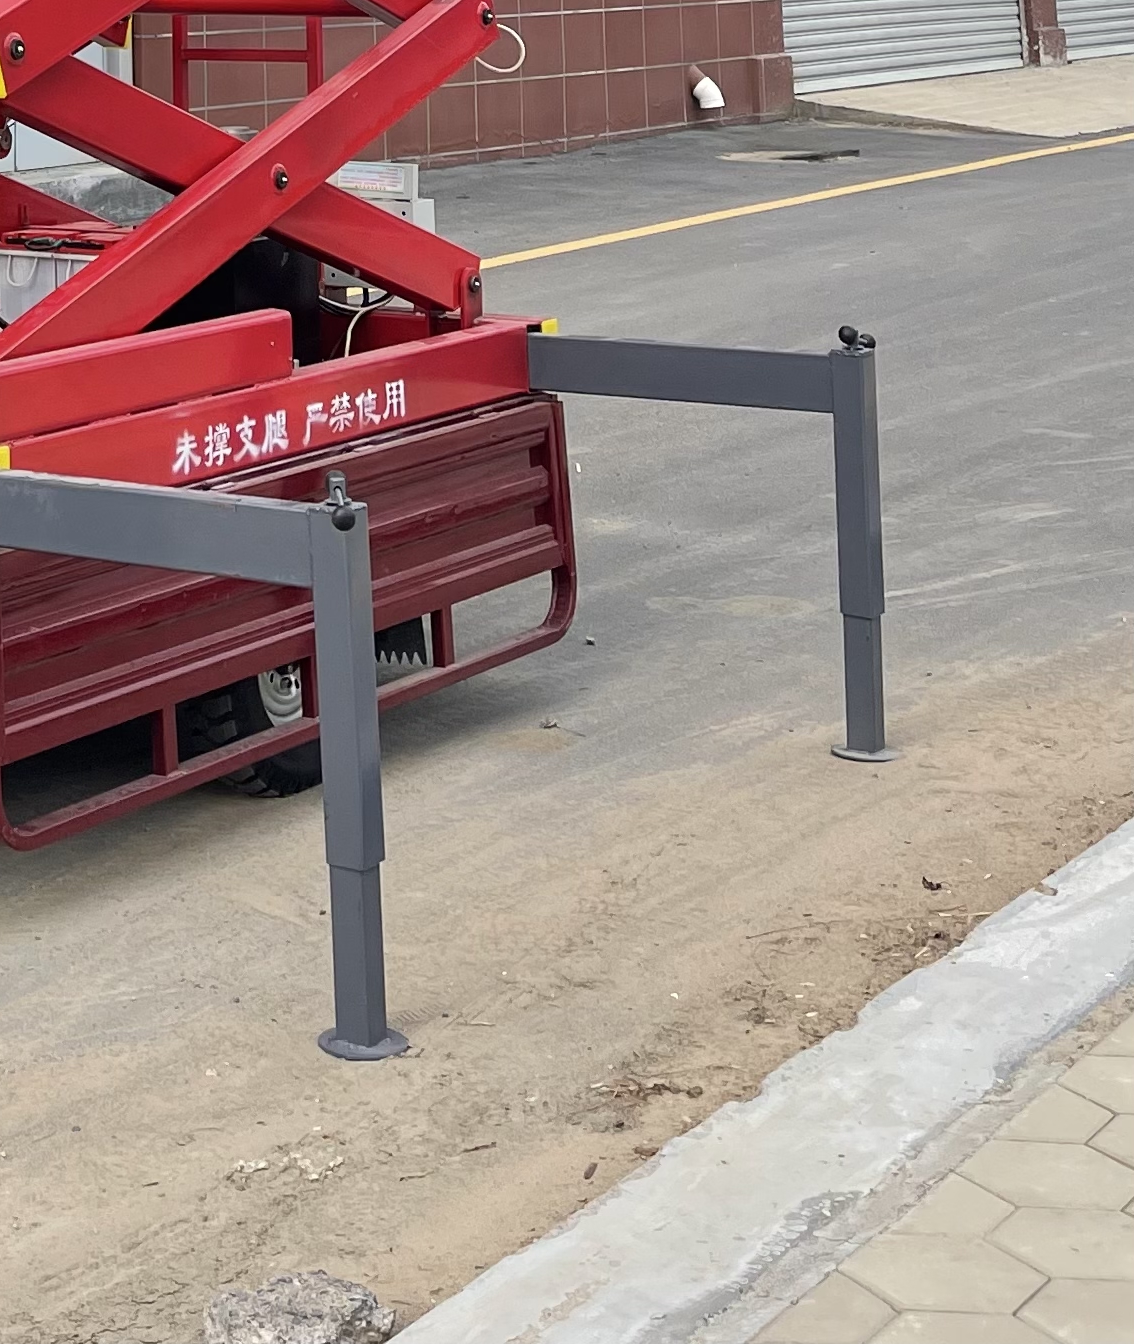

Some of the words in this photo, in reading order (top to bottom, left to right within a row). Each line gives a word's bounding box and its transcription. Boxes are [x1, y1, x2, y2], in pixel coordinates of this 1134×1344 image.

[172, 408, 290, 476] 未撑支腿
[303, 378, 406, 446] 严禁使用
